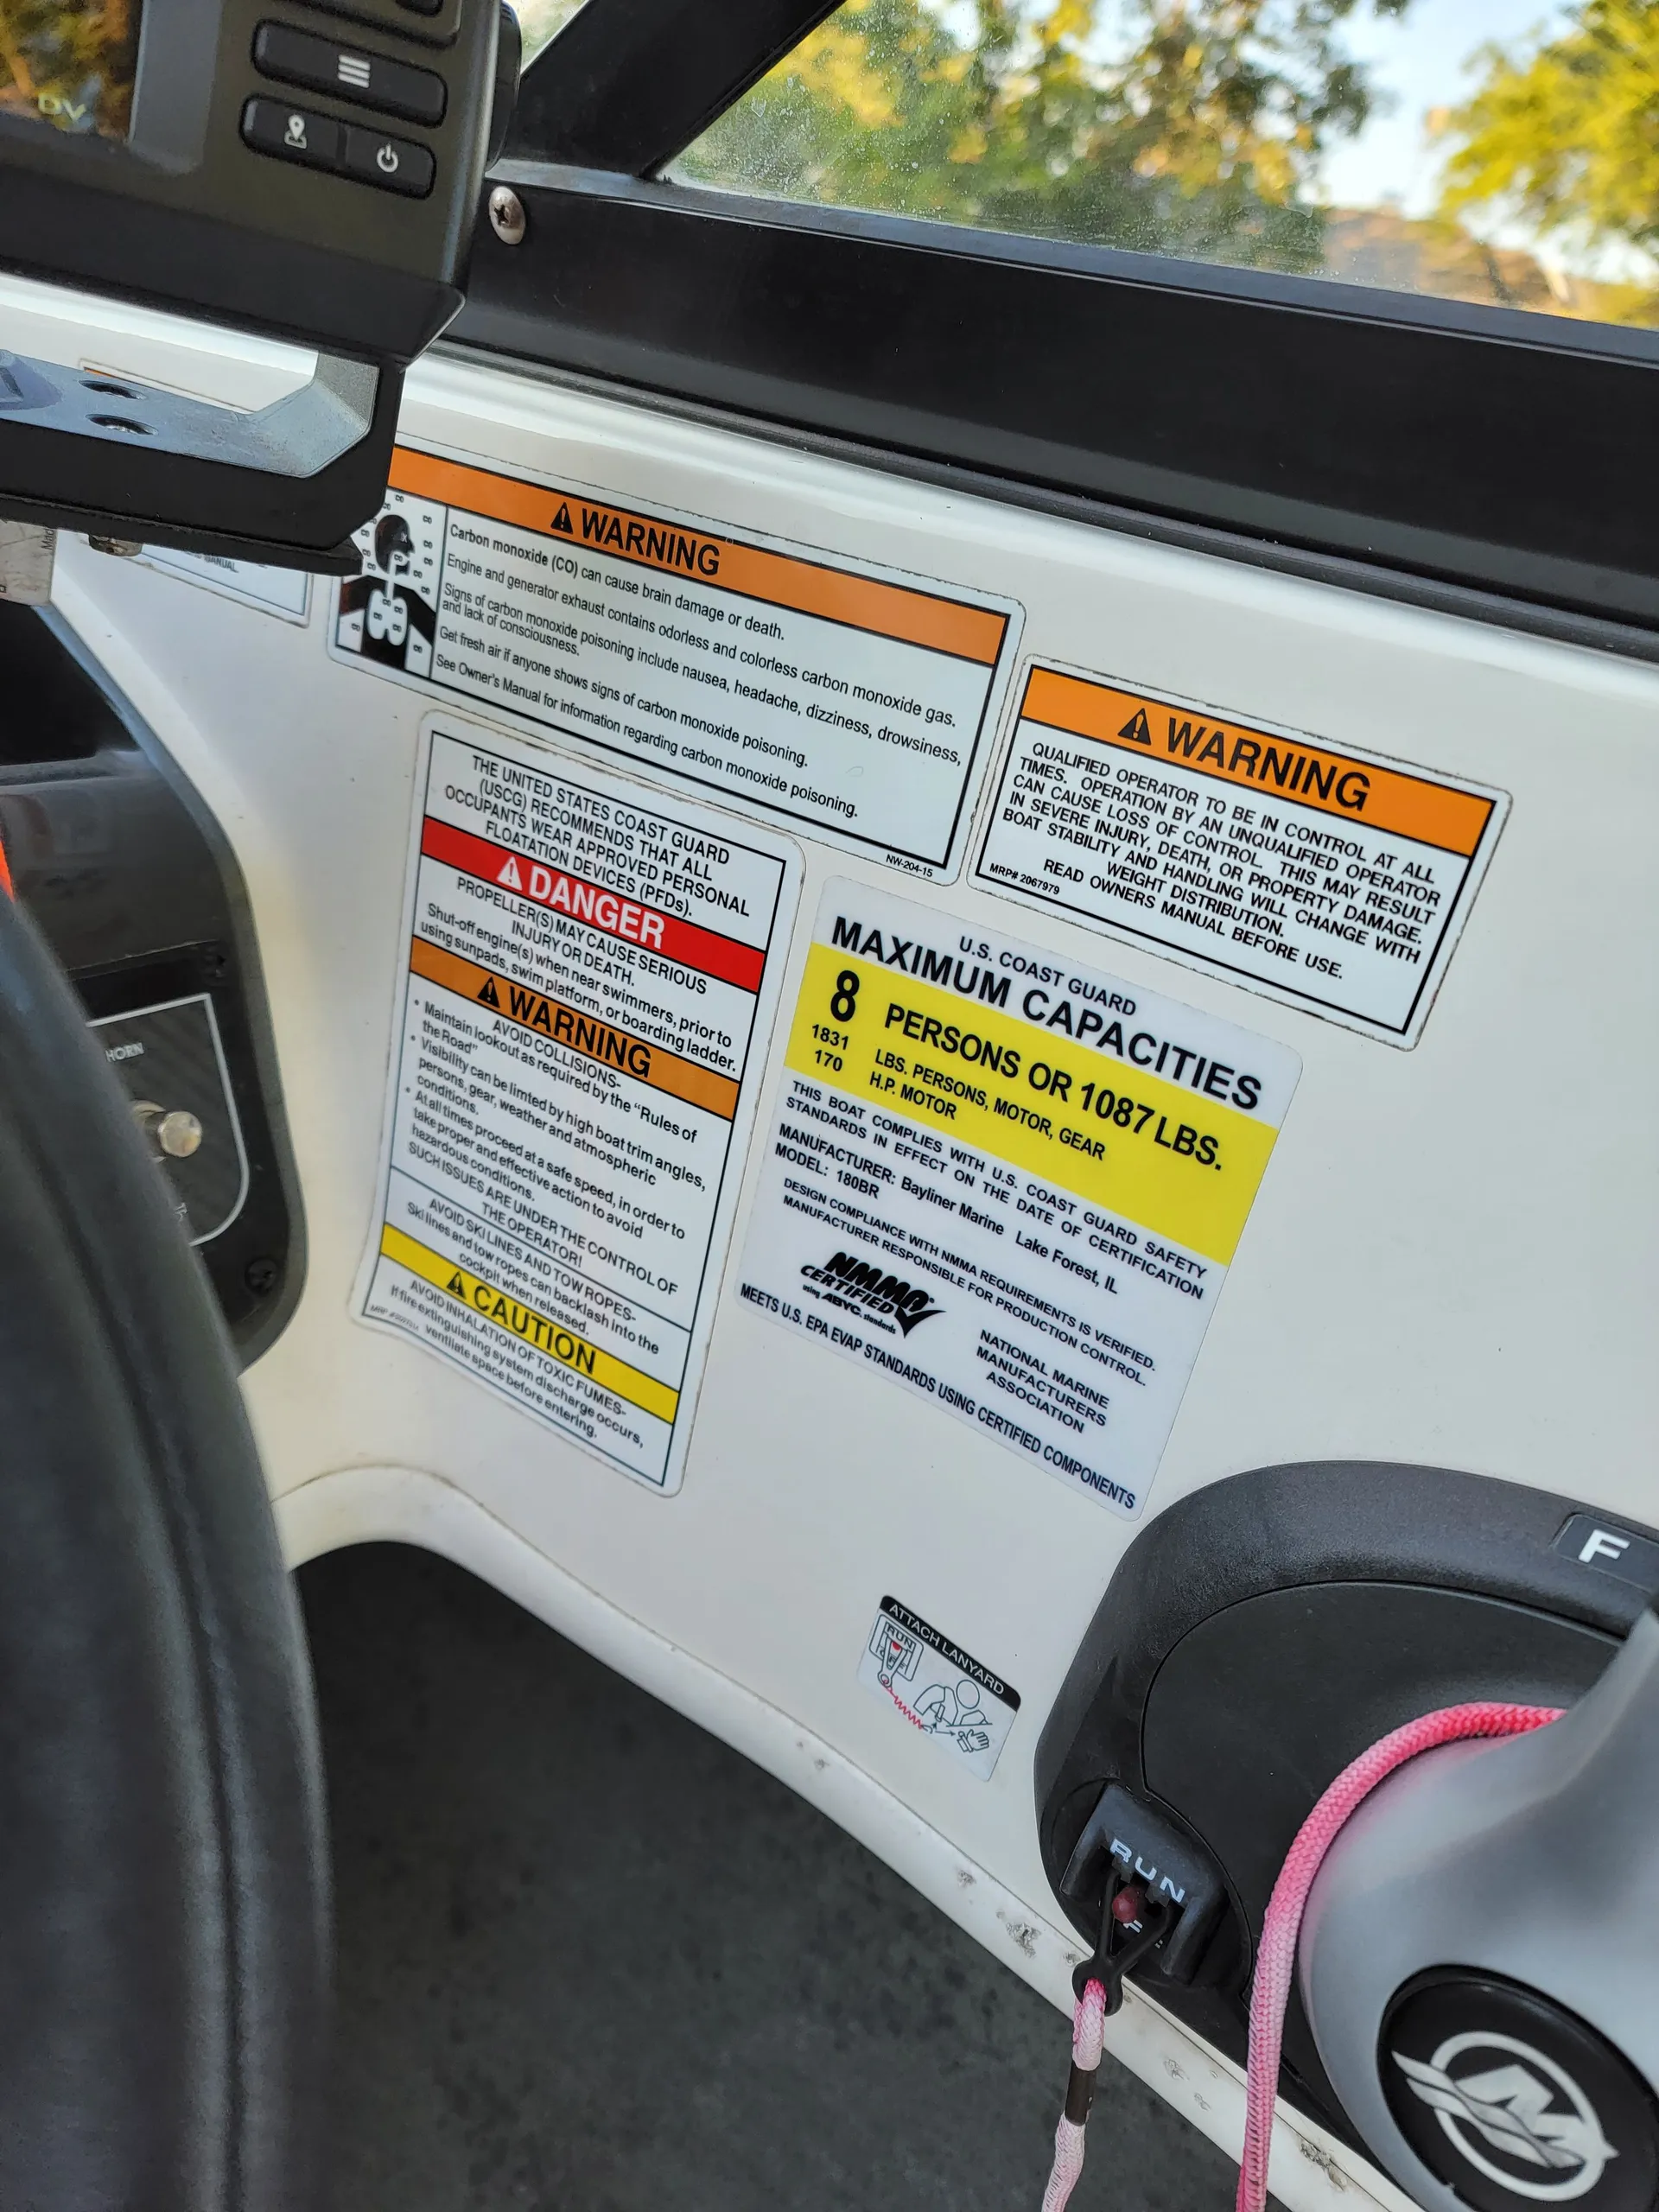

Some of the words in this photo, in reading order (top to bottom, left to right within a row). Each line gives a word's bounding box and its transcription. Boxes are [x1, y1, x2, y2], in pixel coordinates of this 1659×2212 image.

[450, 524, 490, 548] Carbon
[493, 539, 549, 566] monoxide
[551, 555, 578, 579] (CO)
[581, 567, 601, 583] can
[604, 575, 639, 594] cause
[642, 582, 671, 606] brain
[675, 594, 725, 622] damage
[728, 613, 742, 626] or
[744, 615, 785, 640] death.
[582, 507, 720, 576] WARNING
[442, 600, 461, 615] and
[464, 605, 485, 623] lack
[486, 614, 499, 627] of
[499, 619, 580, 657] consciousness.
[447, 552, 482, 576] Engine
[485, 569, 505, 584] and
[506, 575, 560, 601] generator
[561, 593, 606, 617] exhaust
[607, 608, 656, 633] contains
[658, 625, 709, 651] odorless
[712, 642, 737, 659] and
[740, 651, 798, 678] colorless
[801, 670, 849, 695] carbon
[852, 685, 922, 716] monoxide
[925, 708, 956, 728] gas.
[436, 653, 456, 672] See
[458, 662, 500, 689] Owner's
[502, 677, 542, 704] Manual
[543, 692, 559, 709] for
[560, 698, 620, 734] information
[623, 725, 678, 757] regarding
[681, 746, 723, 771] carbon
[725, 761, 788, 792] monoxide
[790, 784, 858, 818] poisoning.
[1167, 716, 1370, 812] WARNING
[445, 785, 527, 830] OCCUPANTS
[531, 817, 573, 848] WEAR
[575, 837, 658, 880] APPROVED
[662, 869, 750, 918] PERSONAL
[473, 754, 499, 779] THE
[502, 766, 553, 798] UNITED
[556, 787, 610, 821] STATES
[614, 810, 669, 842] COAST
[671, 831, 730, 865] GUARD
[480, 779, 527, 813] (USCG)
[531, 798, 634, 851] RECOMMENDS
[639, 839, 680, 868] THAT
[681, 857, 713, 881] ALL
[1020, 756, 1067, 785] TIMES.
[1080, 777, 1168, 817] OPERATION
[1172, 805, 1196, 824] BY
[1198, 816, 1224, 835] AN
[1228, 824, 1339, 872] UNQUALIFIED
[1345, 864, 1441, 907] OPERATOR
[1033, 742, 1111, 777] QUALIFIED
[1116, 768, 1199, 807] OPERATOR
[1206, 796, 1227, 815] TO
[1231, 805, 1256, 825] BE
[1260, 814, 1280, 833] IN
[1284, 823, 1367, 862] CONTROL
[1373, 852, 1398, 870] AT
[1402, 861, 1434, 885] ALL
[486, 820, 569, 867] FLOATATION
[573, 855, 636, 893] DEVICES
[639, 882, 692, 918] (PFDs).
[530, 866, 664, 950] DANGER
[886, 854, 933, 878] NW-204-15
[989, 862, 1019, 880] MRP#
[1019, 874, 1060, 895] 2067979
[1107, 861, 1167, 893] WEIGHT
[1170, 884, 1284, 938] DISTRIBUTION.
[457, 876, 554, 933] PROPELLER(S)
[556, 918, 586, 943] MAY
[586, 932, 637, 966] CAUSE
[638, 954, 707, 995] SERIOUS
[512, 919, 561, 952] INJURY
[562, 943, 582, 963] OR
[583, 951, 634, 987] DEATH.
[1043, 858, 1084, 883] READ
[1090, 875, 1156, 909] OWNERS
[1160, 900, 1225, 937] MANUAL
[1231, 926, 1300, 963] BEFORE
[1305, 952, 1343, 979] USE.
[831, 915, 1012, 1008] MAXIMUM
[1022, 988, 1262, 1110] CAPACITIES
[959, 936, 993, 962] U.S.
[999, 951, 1065, 987] COAST
[1067, 978, 1136, 1016] GUARD
[105, 1042, 145, 1063] HORN
[492, 1019, 533, 1047] AVOID
[534, 1039, 621, 1089] COLLISIONS-
[509, 985, 652, 1078] WARNING
[830, 969, 860, 1022] 8
[884, 1002, 1021, 1078] PERSONS
[1028, 1062, 1072, 1103] OR
[1081, 1082, 1155, 1135] 1087
[1154, 1116, 1222, 1171] LBS.
[811, 1024, 849, 1051] 1831
[874, 1048, 907, 1075] LBS.
[912, 1063, 988, 1111] PERSONS,
[993, 1096, 1053, 1141] MOTOR,
[1058, 1128, 1106, 1161] GEAR
[815, 1049, 843, 1072] 170
[869, 1071, 896, 1095] H.P.
[899, 1084, 957, 1121] MOTOR
[774, 1142, 829, 1177] MODEL:
[836, 1169, 880, 1199] 180BR
[779, 1122, 896, 1185] MANUFACTURER:
[900, 1175, 957, 1211] Bayliner
[958, 1202, 1004, 1236] Marine
[1015, 1230, 1049, 1258] Lake
[1052, 1249, 1100, 1287] Forest,
[1104, 1275, 1118, 1294] IL
[459, 1253, 500, 1284] cockpit
[502, 1277, 533, 1303] when
[534, 1296, 589, 1336] released.
[474, 1285, 596, 1375] CAUTION
[783, 1194, 880, 1247] MANUFACTURER
[881, 1239, 966, 1289] RESPONSIBLE
[967, 1281, 994, 1304] FOR
[995, 1296, 1078, 1349] PRODUCTION
[1080, 1343, 1146, 1387] CONTROL.
[800, 1265, 895, 1314] CERTIFIED
[802, 1284, 821, 1300] using
[863, 1313, 897, 1335] standards
[425, 1325, 471, 1359] ventilate
[471, 1354, 505, 1381] space
[505, 1373, 543, 1404] before
[544, 1399, 597, 1439] entering.
[740, 1282, 779, 1313] MEETS
[781, 1302, 803, 1325] U.S.
[805, 1314, 829, 1338] EPA
[830, 1326, 863, 1352] EVAP
[863, 1344, 937, 1393] STANDARDS
[938, 1382, 976, 1415] USING
[977, 1406, 1042, 1453] CERTIFIED
[1043, 1445, 1135, 1510] COMPONENTS
[976, 1345, 1107, 1427] MANUFACTURERS
[980, 1329, 1048, 1376] NATIONAL
[1052, 1369, 1109, 1409] MARINE
[986, 1371, 1085, 1433] ASSOCIATION
[1579, 1529, 1630, 1564] F
[887, 1623, 916, 1650] RUN
[888, 1604, 941, 1648] ATTACH
[942, 1642, 1005, 1696] LANYARD
[1109, 1838, 1186, 1904] RUN
